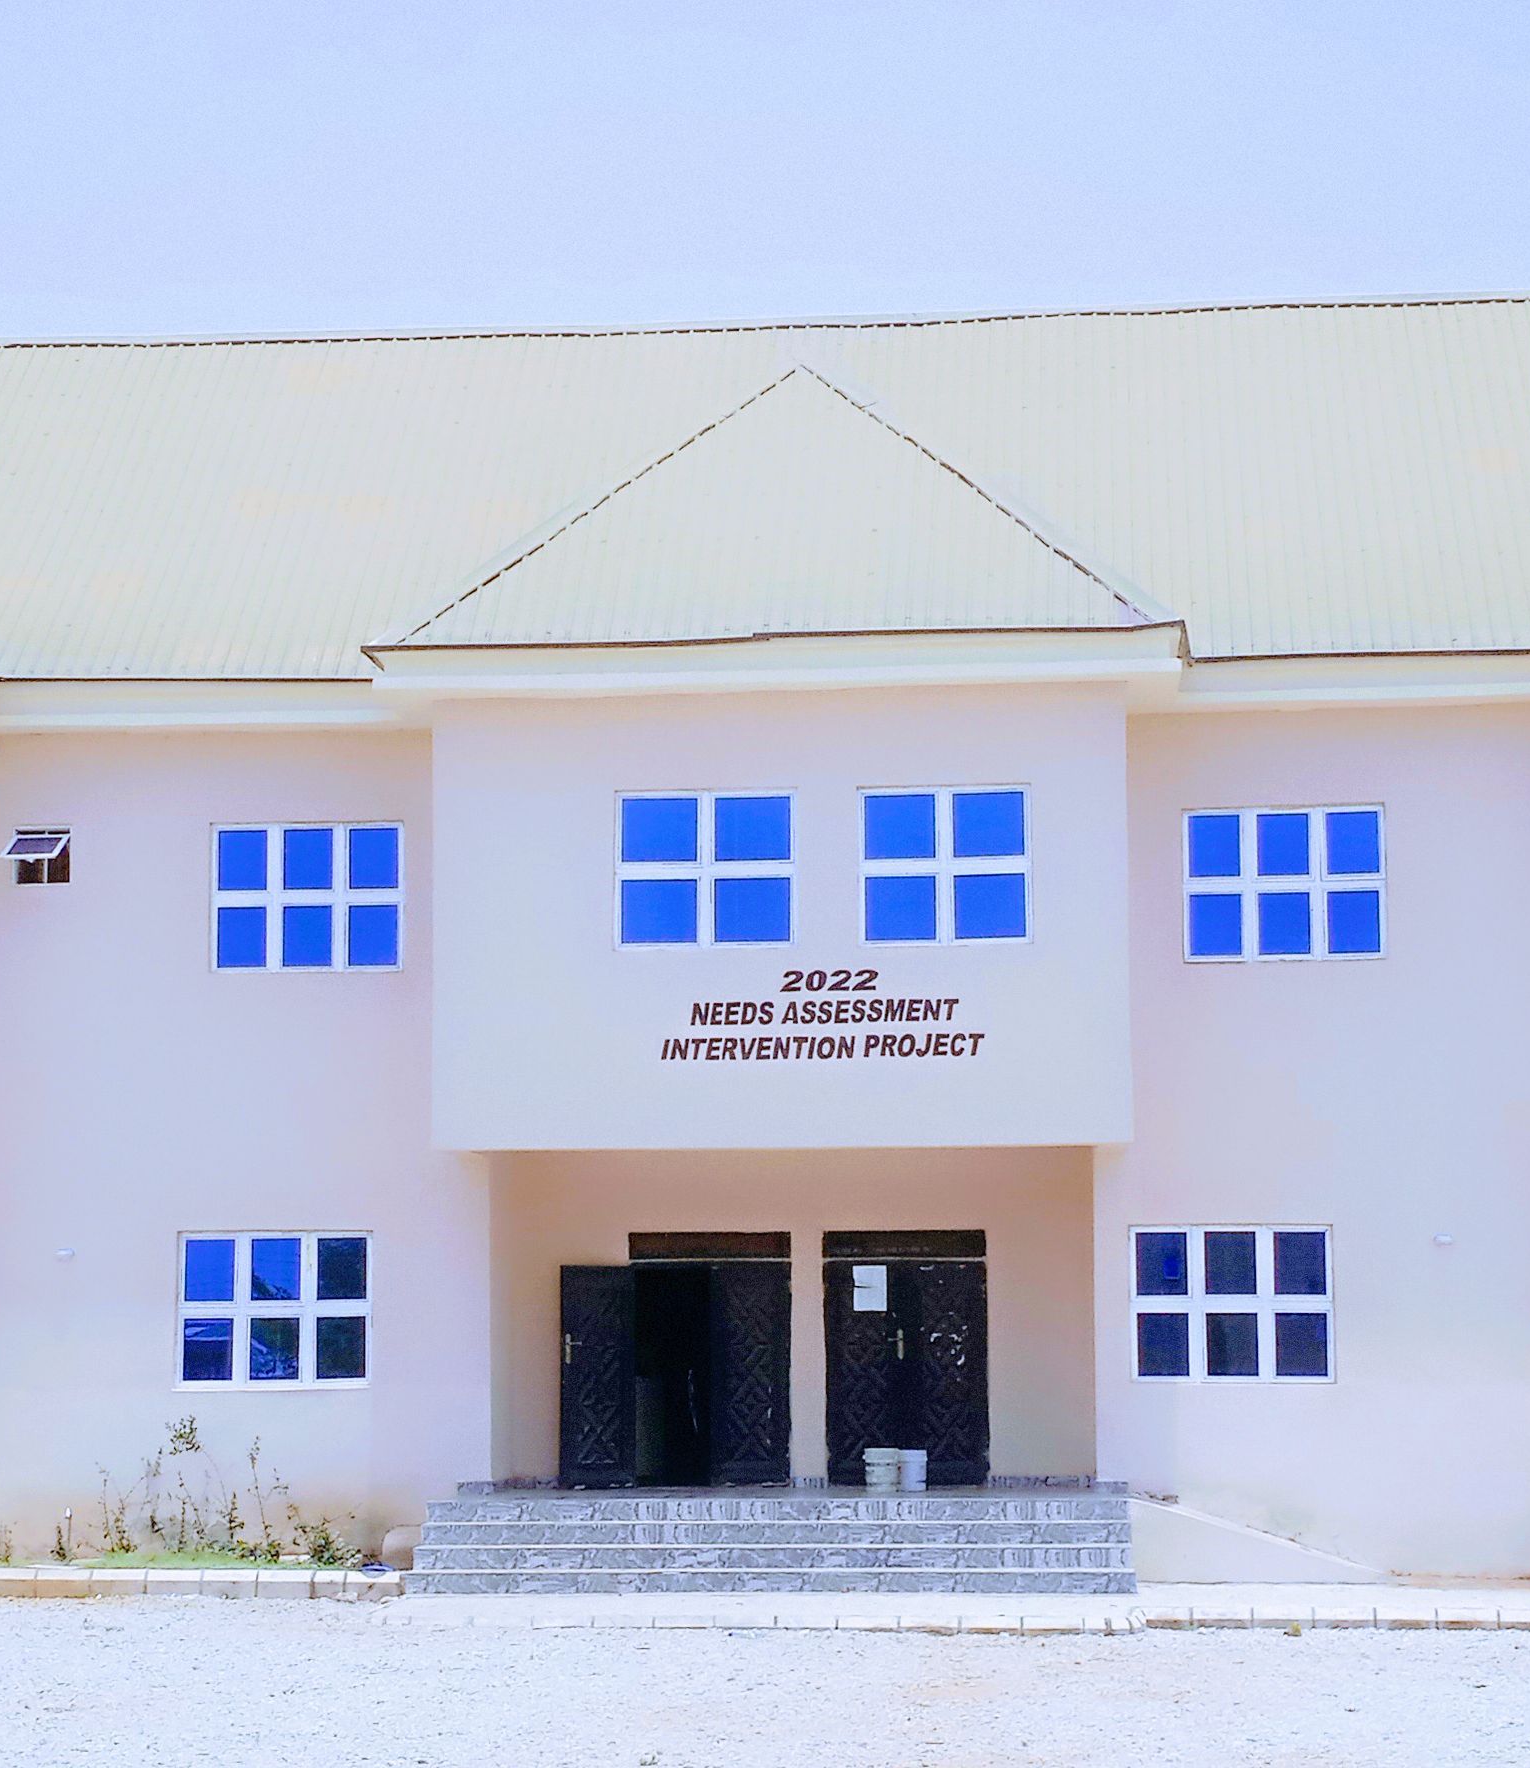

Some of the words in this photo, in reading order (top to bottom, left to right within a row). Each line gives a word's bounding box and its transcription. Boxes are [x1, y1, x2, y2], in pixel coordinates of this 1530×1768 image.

[779, 969, 879, 992] 2022
[690, 1001, 774, 1025] NEEDS
[780, 998, 959, 1024] ASSESSMENT
[660, 1036, 855, 1060] INTERVENTION
[863, 1033, 985, 1058] PROJECT
